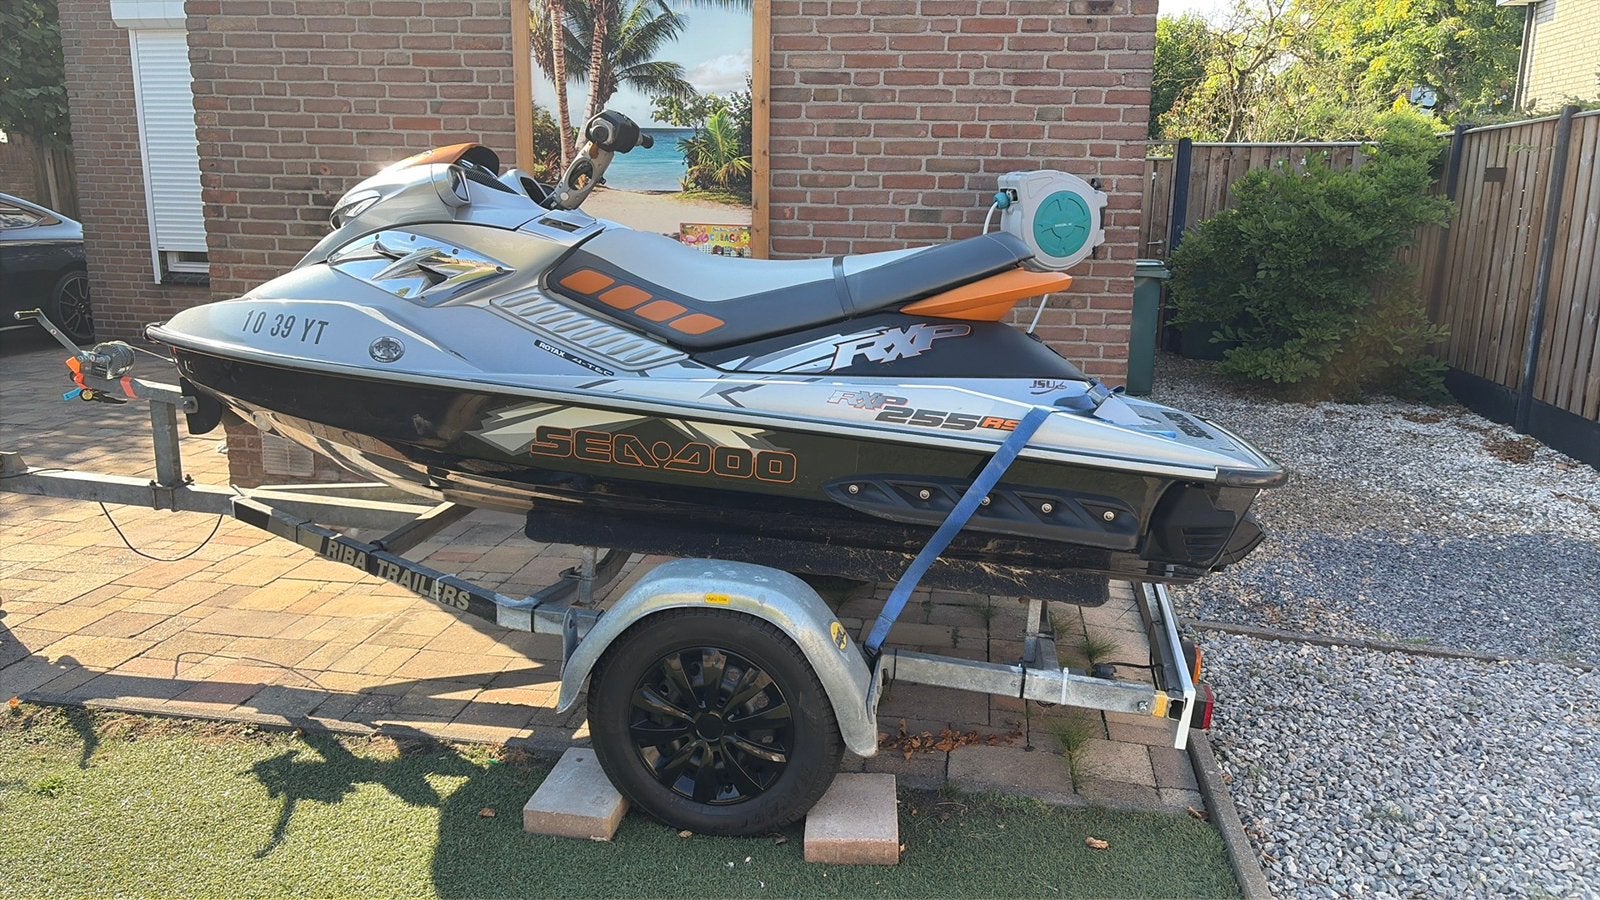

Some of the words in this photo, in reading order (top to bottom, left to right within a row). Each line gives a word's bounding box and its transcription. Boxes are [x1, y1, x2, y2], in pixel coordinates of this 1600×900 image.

[242, 310, 266, 334] 10
[270, 313, 296, 338] 39
[301, 318, 329, 344] YT
[829, 322, 972, 373] RXP
[538, 341, 566, 359] ROTAX
[827, 389, 909, 411] RXP
[875, 405, 981, 430] 255
[980, 416, 1021, 432] RS
[326, 541, 366, 570] RIBA
[376, 558, 471, 611] TRAILERS
